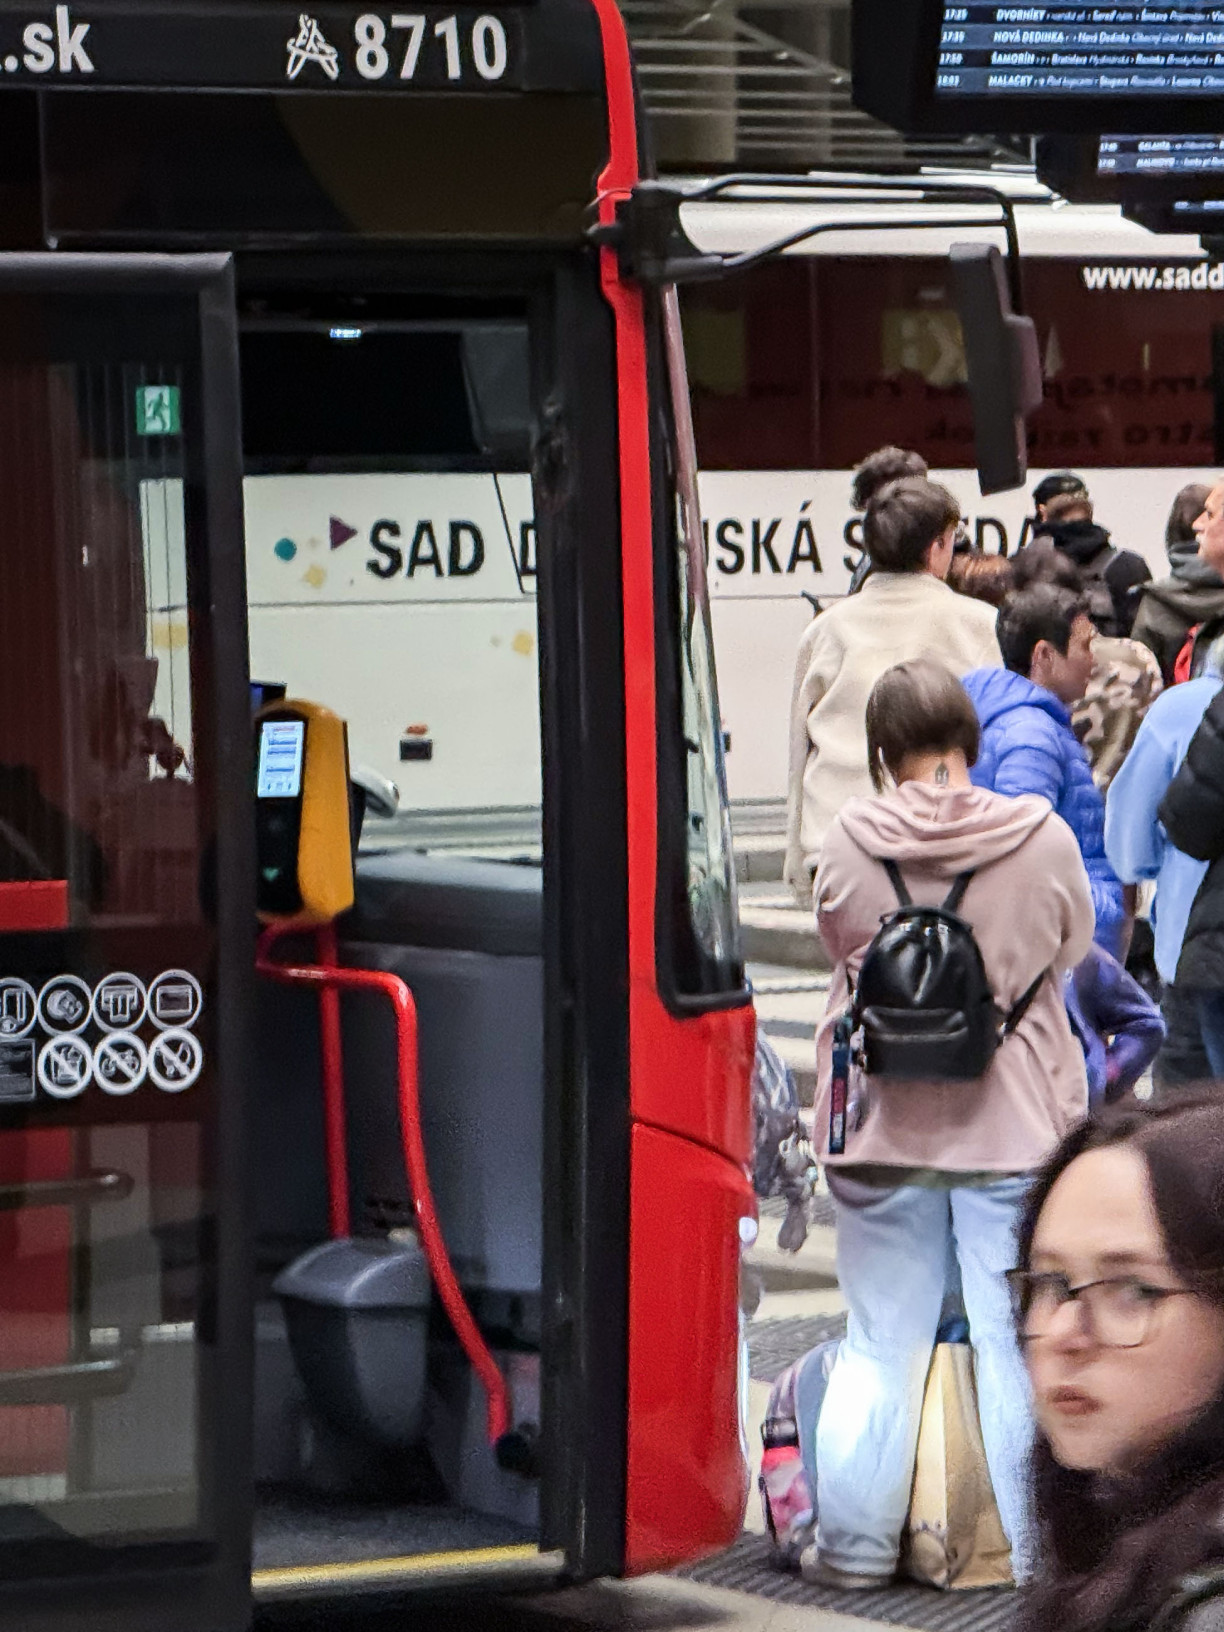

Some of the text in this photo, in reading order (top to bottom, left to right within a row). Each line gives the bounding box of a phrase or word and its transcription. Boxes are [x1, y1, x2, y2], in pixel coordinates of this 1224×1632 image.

[0, 4, 96, 74] .sk
[354, 13, 508, 81] 8710
[993, 29, 1021, 43] NOVÁ
[366, 518, 485, 579] SAD
